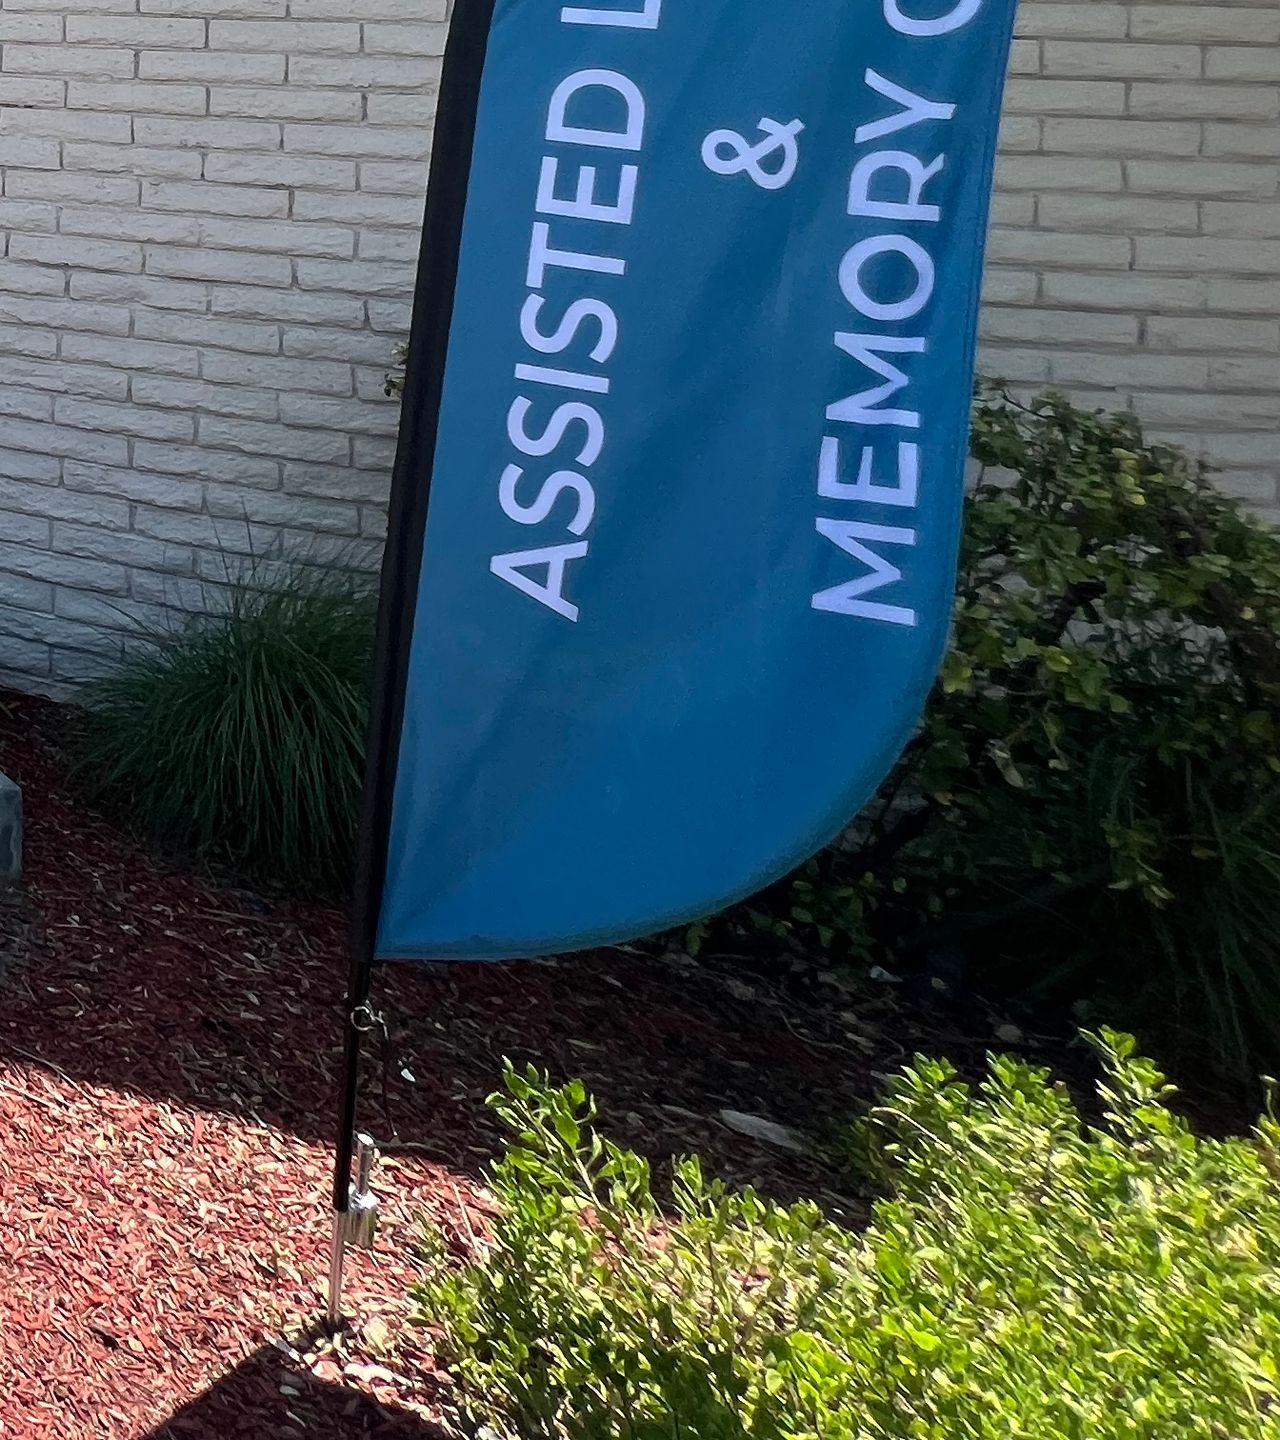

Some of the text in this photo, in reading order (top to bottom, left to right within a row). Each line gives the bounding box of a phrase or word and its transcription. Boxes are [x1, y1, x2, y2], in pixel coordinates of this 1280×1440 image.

[489, 67, 647, 622] ASSISTED
[700, 115, 805, 190] &
[810, 68, 957, 626] MEMORY
